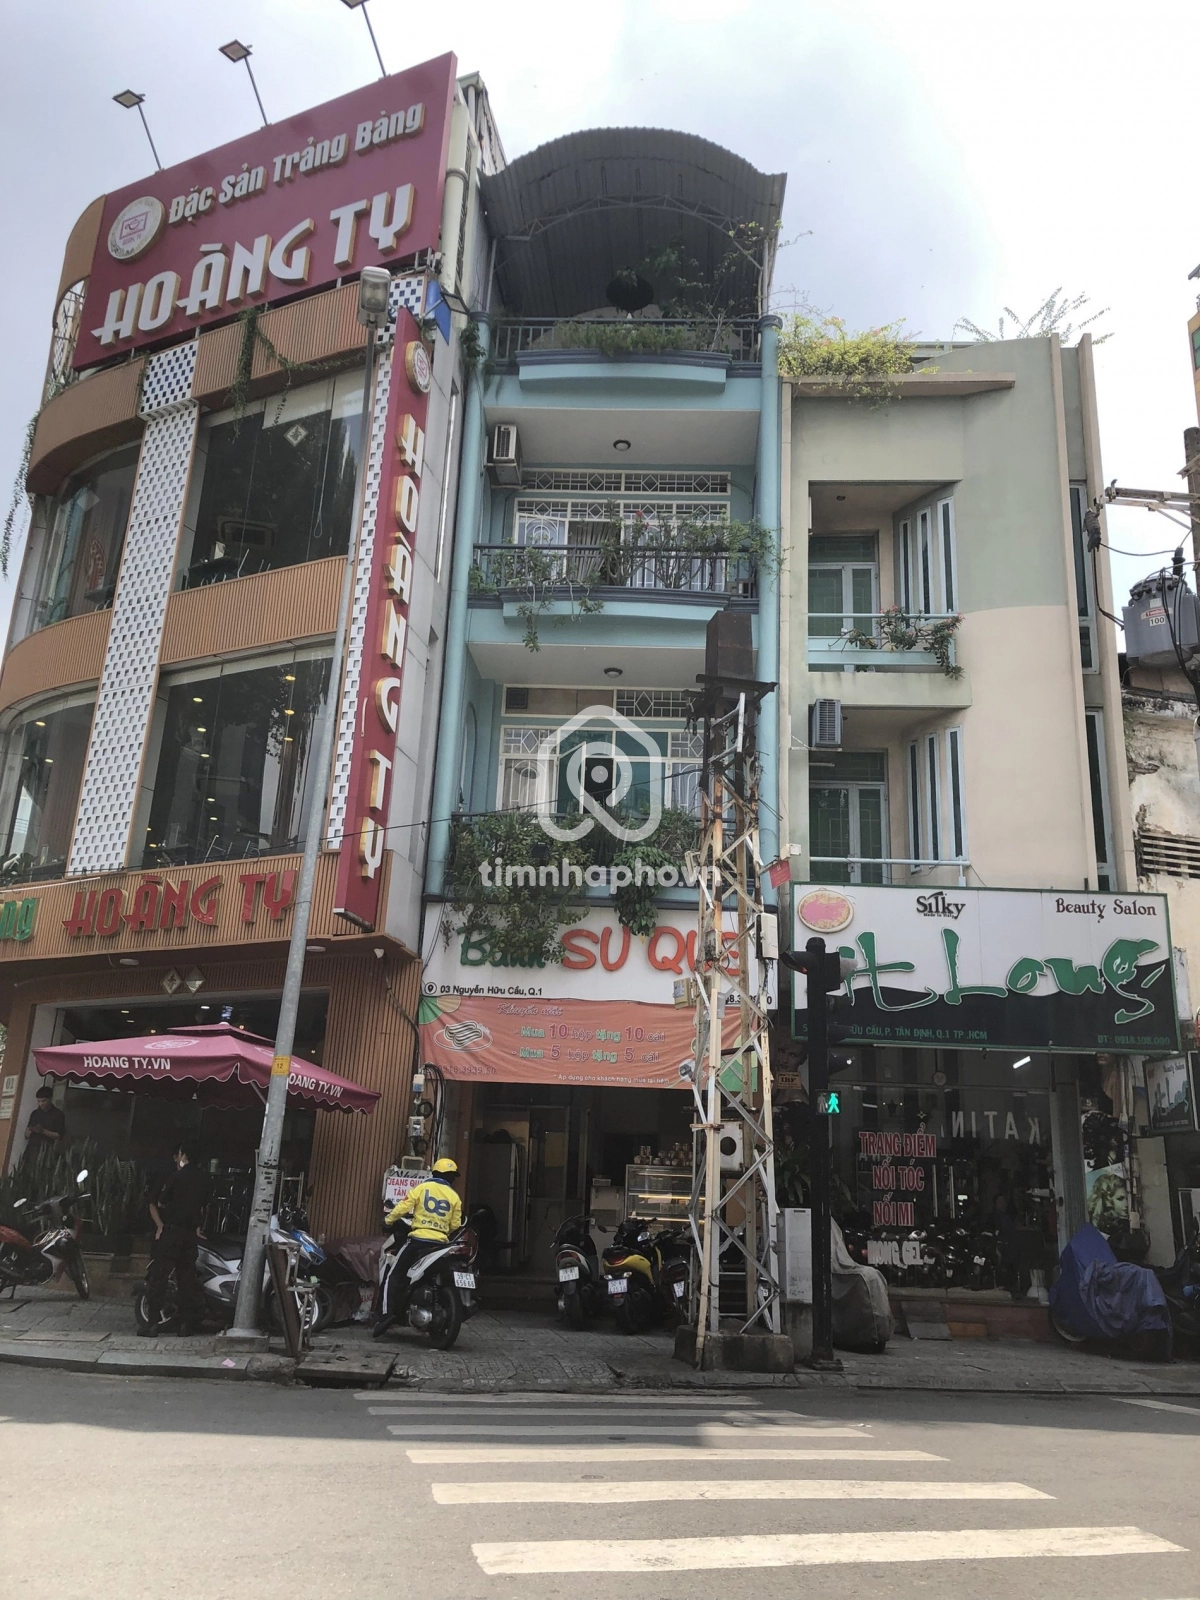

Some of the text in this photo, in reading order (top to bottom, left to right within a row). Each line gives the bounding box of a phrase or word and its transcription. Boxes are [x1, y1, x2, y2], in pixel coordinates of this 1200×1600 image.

[168, 102, 425, 226] Đặc Sản Trảng Bàng
[330, 182, 415, 269] TY
[1150, 616, 1165, 625] 100
[239, 869, 299, 924] TY
[916, 891, 966, 920] Silky
[1055, 898, 1158, 922] Beauty Salon
[440, 985, 451, 994] 03
[453, 984, 484, 996] Nguyễn
[487, 985, 506, 995] Hữu
[528, 987, 543, 996] Q.1
[941, 928, 1166, 1025] Long
[520, 1023, 666, 1043] Mua 10 hộp tặng 10 cái
[83, 1056, 171, 1070] HOANG TY.VN
[519, 1043, 660, 1064] Mua 5 hộp tặng 5 cái
[286, 1072, 344, 1098] OANG TY.VN
[859, 1122, 937, 1158] TRANG ĐIỂM
[388, 1178, 408, 1187] JEANS
[872, 1157, 925, 1192] NỐI TÓC
[423, 1189, 451, 1218] be
[873, 1192, 915, 1227] NỐI MI
